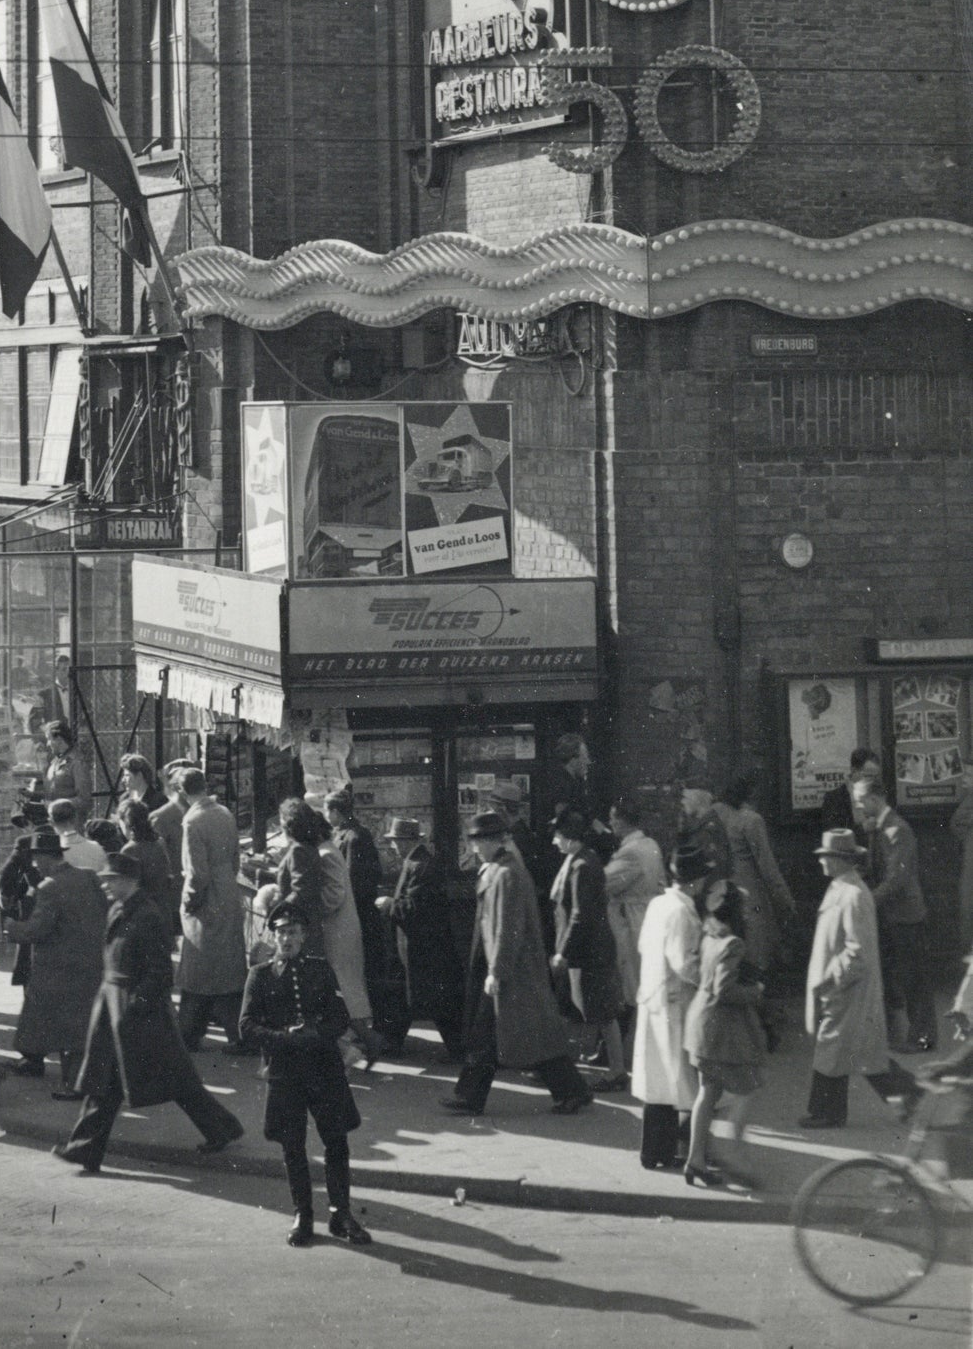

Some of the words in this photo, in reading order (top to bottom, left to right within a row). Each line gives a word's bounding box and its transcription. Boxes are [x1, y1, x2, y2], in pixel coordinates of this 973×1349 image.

[541, 44, 761, 173] 50
[755, 338, 814, 350] VREDENBURG
[414, 543, 435, 553] van
[437, 536, 466, 550] Gend
[475, 531, 501, 543] Loos
[388, 611, 483, 631] SUCCES
[304, 659, 335, 670] HET
[345, 658, 387, 670] BLAD
[398, 657, 429, 669] DER
[439, 655, 509, 667] DUIZEND
[521, 653, 583, 665] KANSEN
